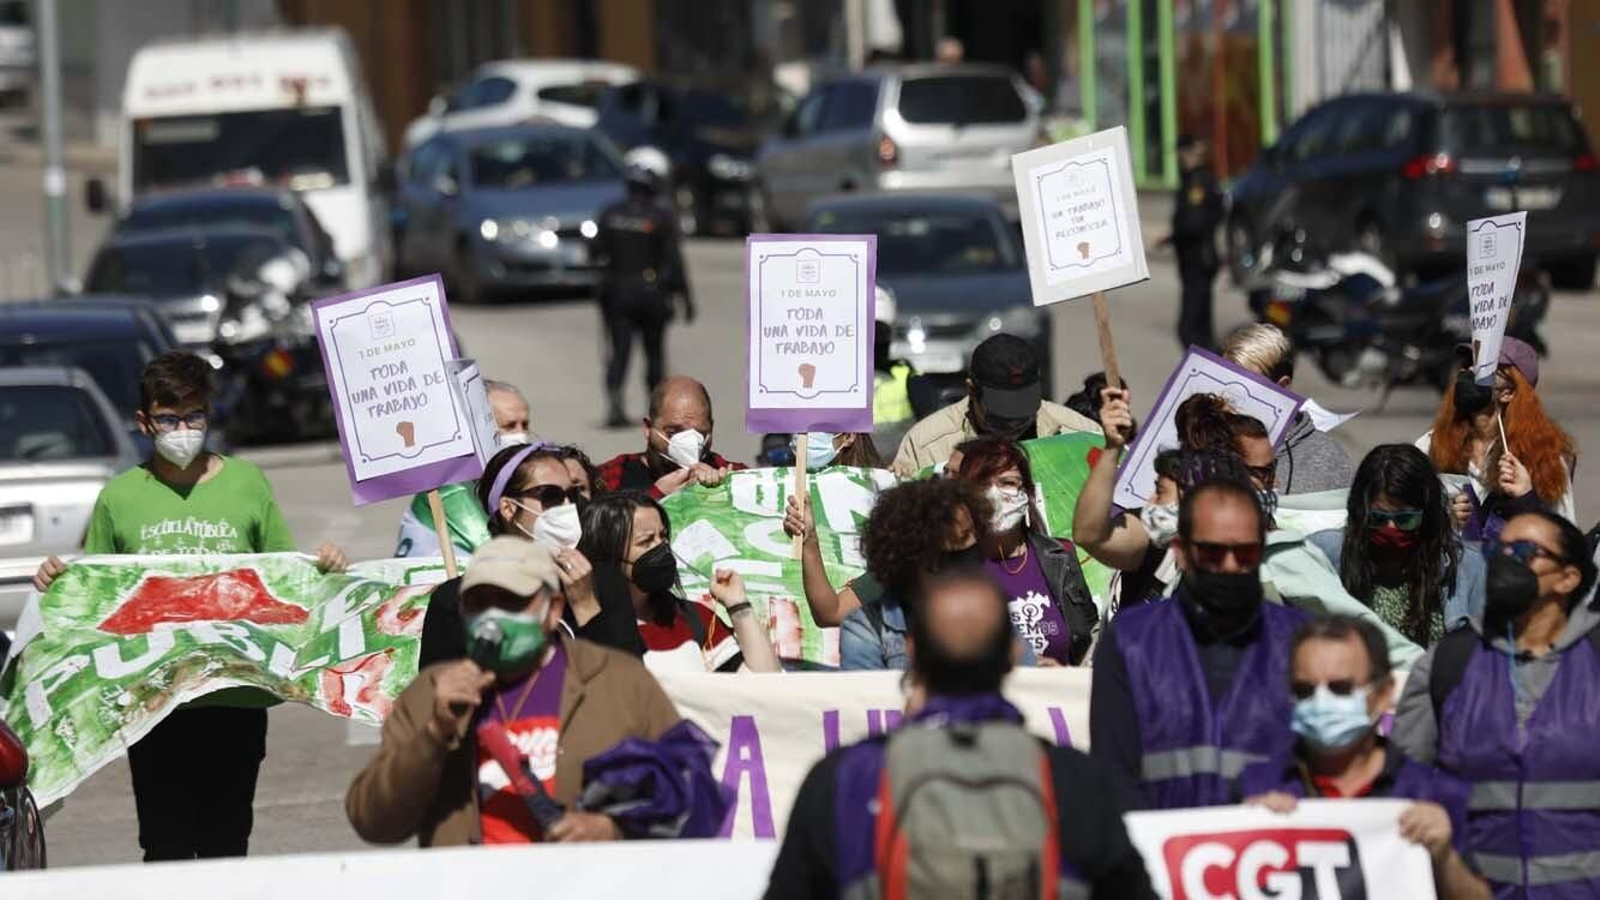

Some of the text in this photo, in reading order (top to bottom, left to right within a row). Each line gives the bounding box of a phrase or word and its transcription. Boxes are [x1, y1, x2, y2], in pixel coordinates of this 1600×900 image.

[1474, 266, 1484, 276] DE
[1485, 261, 1506, 273] MAYO
[788, 290, 803, 298] DE
[805, 289, 837, 298] MAYO
[1471, 281, 1495, 297] TODA
[787, 307, 824, 321] TODA
[1474, 298, 1495, 314] VIDA
[763, 324, 855, 339] UNA VIDA DE
[366, 343, 382, 357] DE
[384, 338, 416, 354] MAYO
[775, 341, 836, 356] TRABAJO
[370, 360, 409, 381] TODA
[351, 370, 445, 404] UNA VIDA DE
[368, 392, 429, 419] TRABAJO
[1180, 840, 1351, 900] CGT
